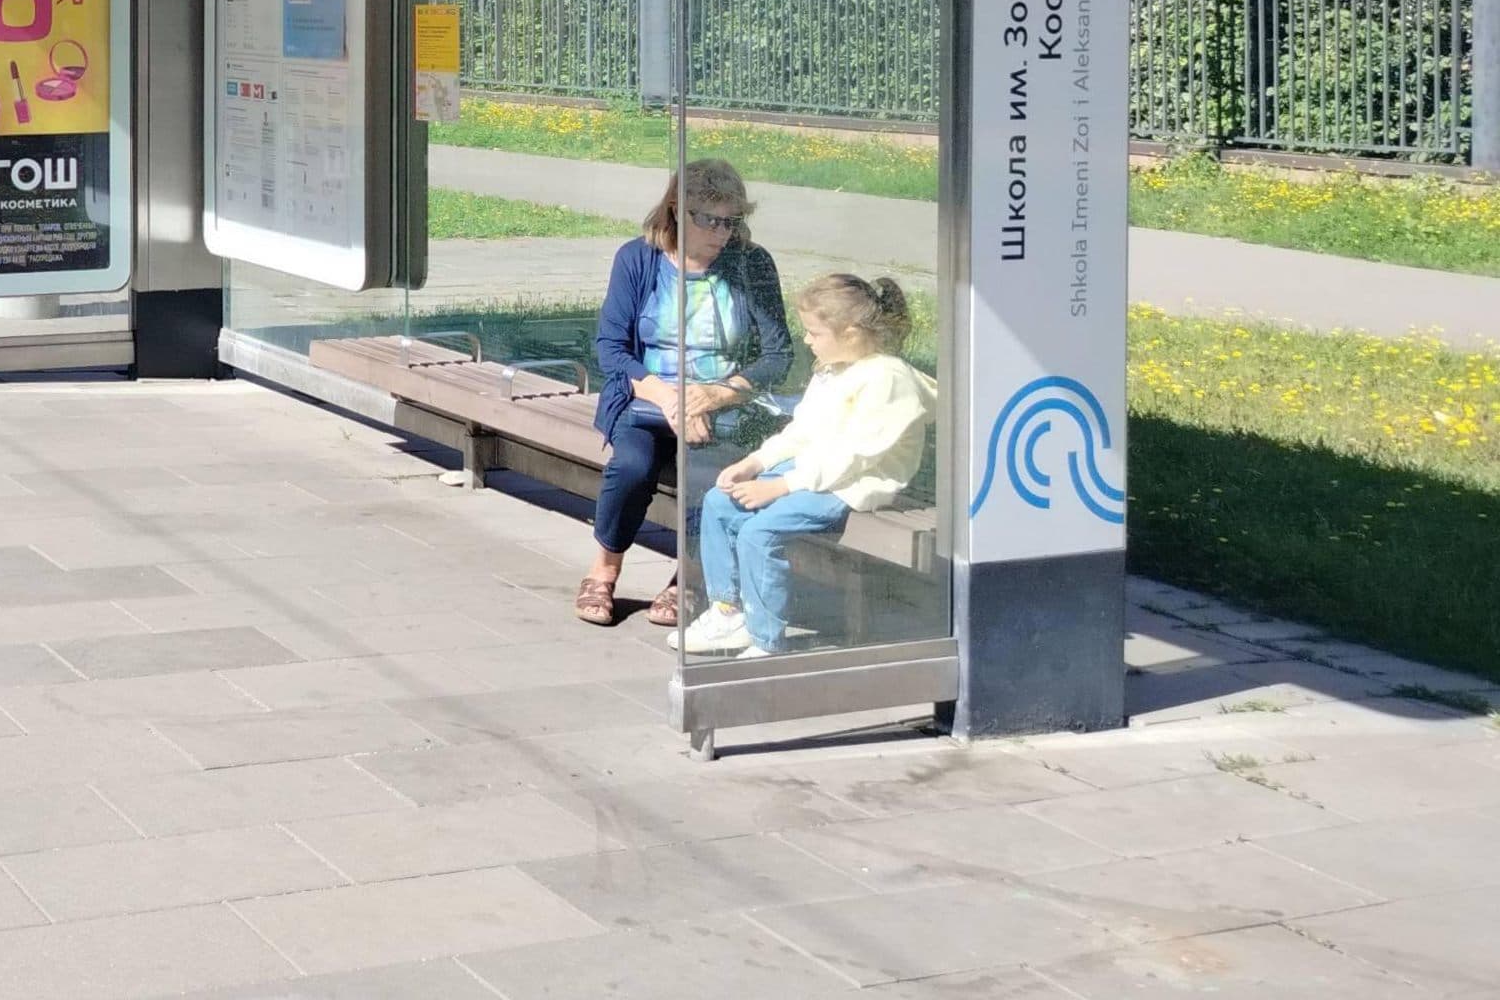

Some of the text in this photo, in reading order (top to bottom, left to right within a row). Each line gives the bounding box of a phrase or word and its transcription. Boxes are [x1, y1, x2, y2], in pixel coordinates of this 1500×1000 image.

[1009, 60, 1028, 120] им.
[1073, 116, 1090, 152] Zoi
[0, 198, 77, 210] КОСМЕТИКА
[1001, 135, 1026, 261] Школа
[1071, 161, 1090, 231] Imeni
[1070, 239, 1088, 317] Shkola
